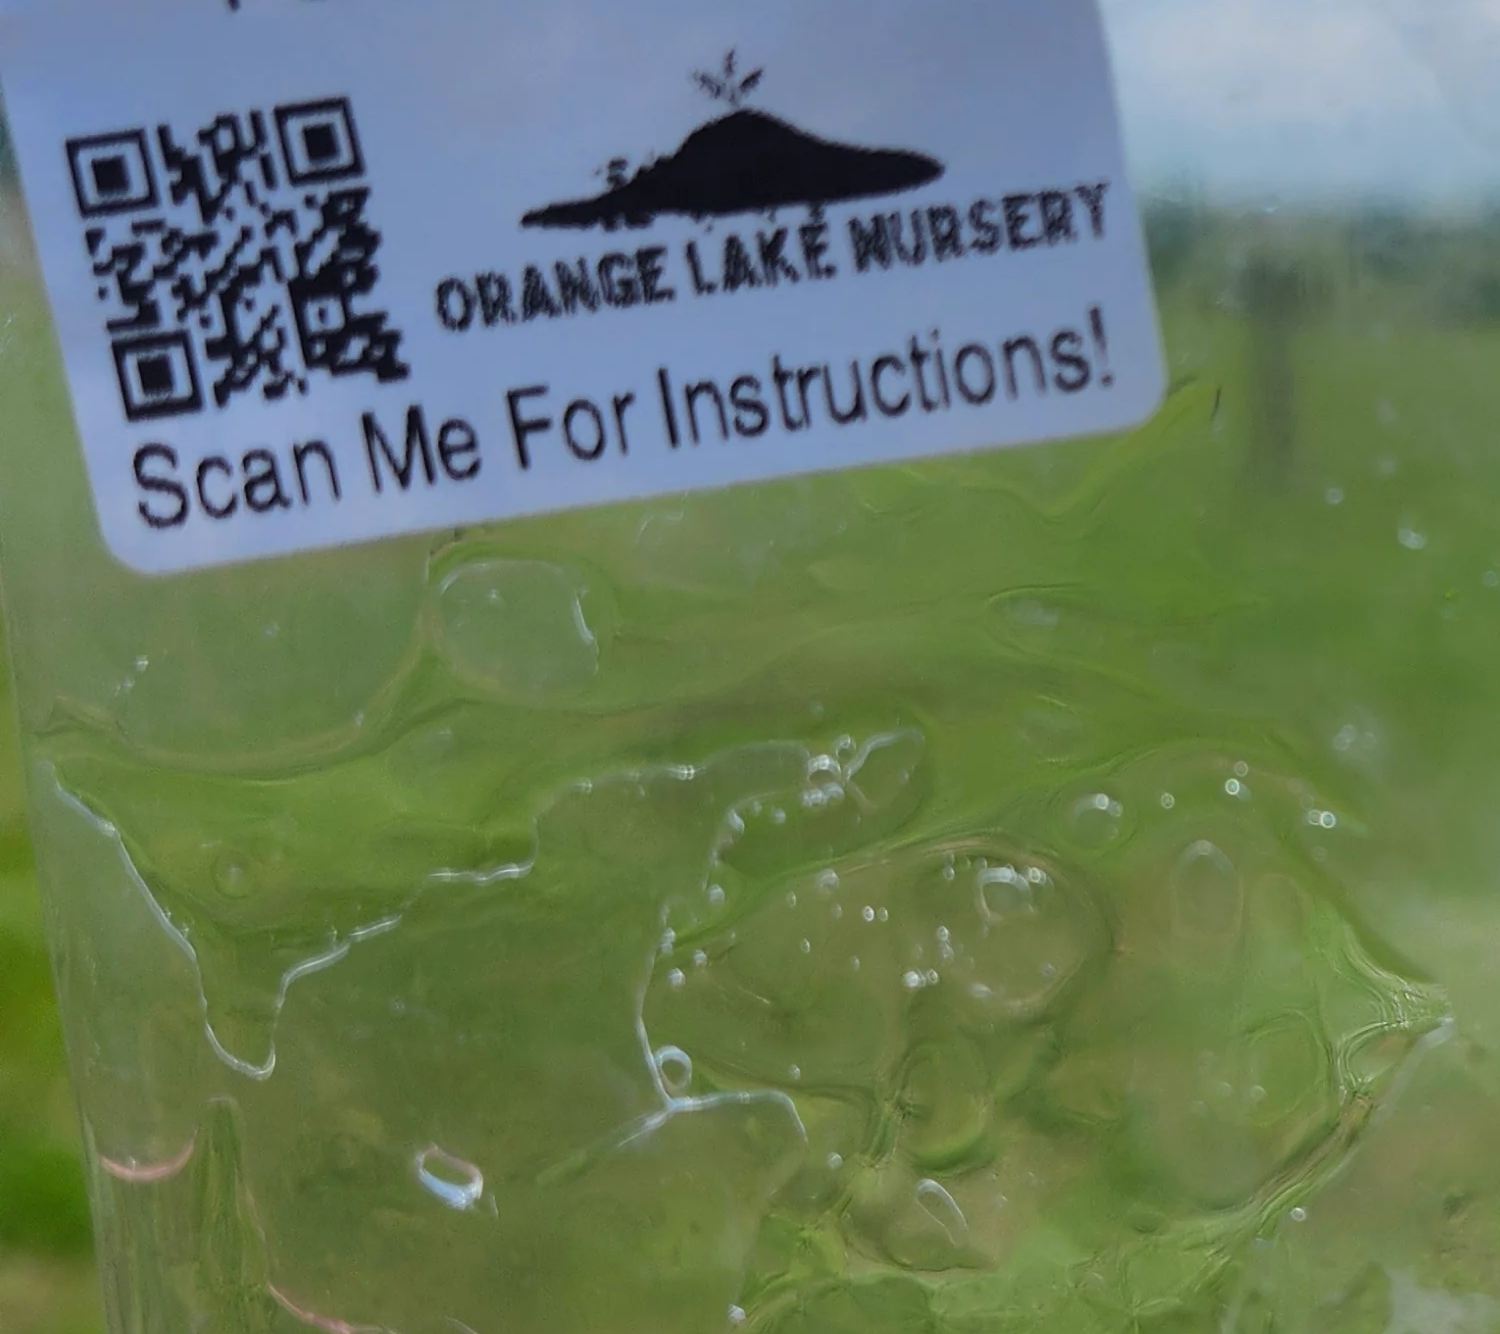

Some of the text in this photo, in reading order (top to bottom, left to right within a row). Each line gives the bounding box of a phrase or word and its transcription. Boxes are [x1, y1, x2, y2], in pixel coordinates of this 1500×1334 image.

[436, 181, 1112, 332] ORANGE LAKE NURSERY
[132, 305, 1116, 529] Scan Me For Instructions!
